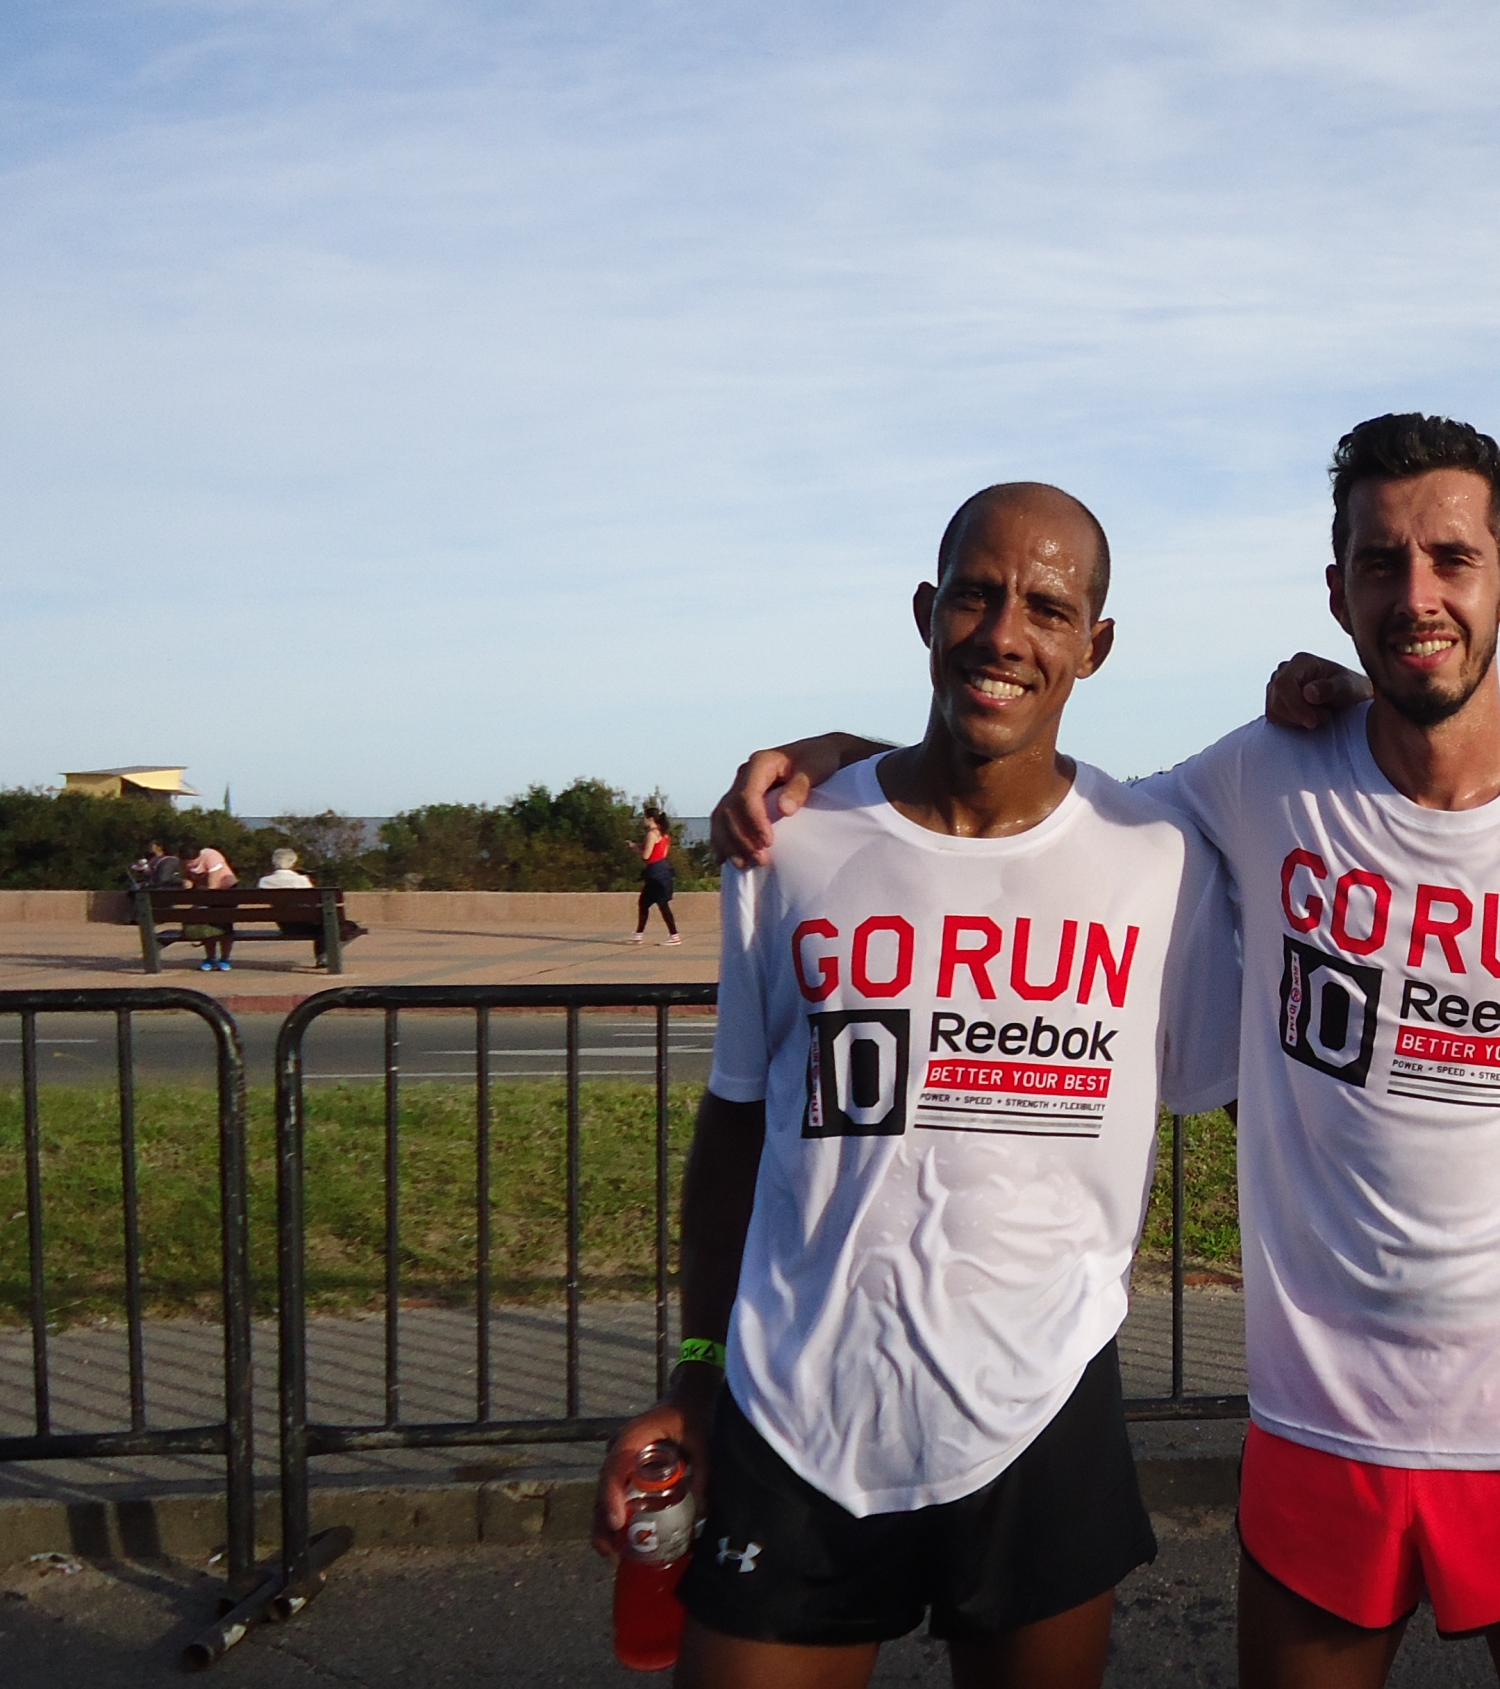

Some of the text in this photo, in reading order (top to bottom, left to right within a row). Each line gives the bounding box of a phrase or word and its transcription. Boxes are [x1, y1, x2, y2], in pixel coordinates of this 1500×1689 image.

[1281, 847, 1393, 956] GO
[791, 914, 1140, 1008] GO RUN
[929, 1011, 1119, 1062] Reebok
[1401, 1034, 1475, 1059] BETTER
[929, 1066, 1108, 1091] BETTER YOUR BEST
[1392, 1059, 1423, 1072] POWER
[1436, 1065, 1466, 1077] SPEED
[919, 1093, 951, 1103] POWER
[963, 1096, 993, 1106] SPEED
[1005, 1098, 1049, 1109] STRENGTH
